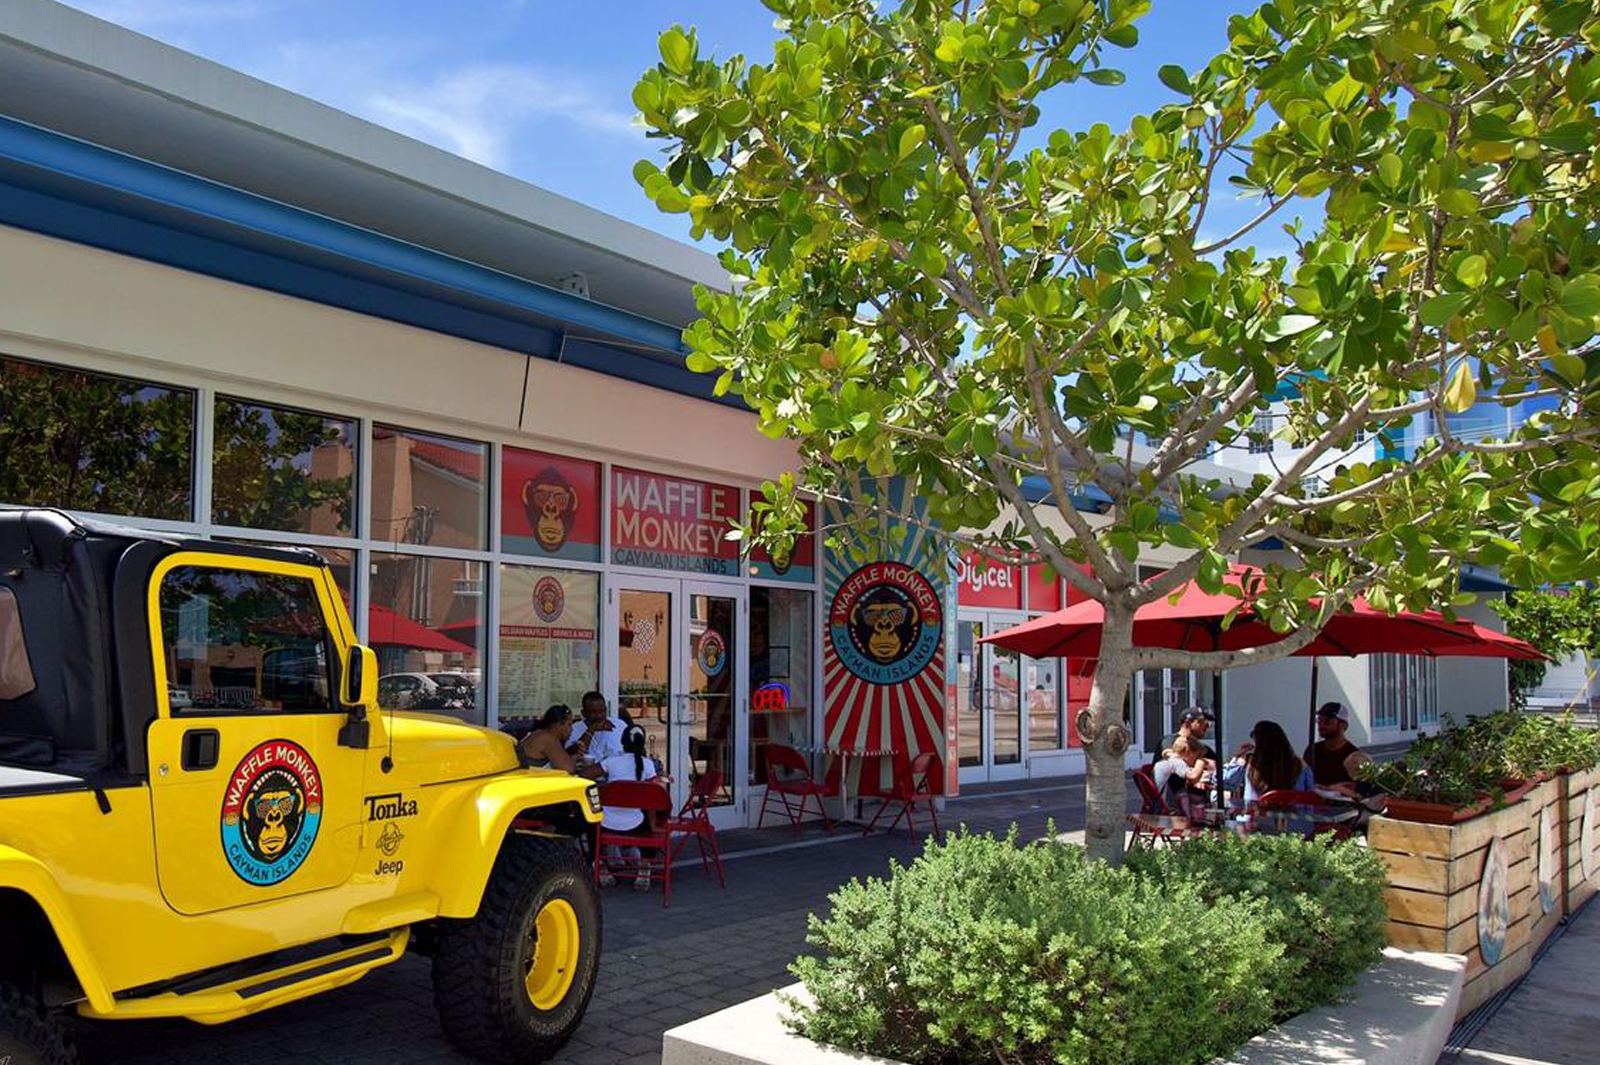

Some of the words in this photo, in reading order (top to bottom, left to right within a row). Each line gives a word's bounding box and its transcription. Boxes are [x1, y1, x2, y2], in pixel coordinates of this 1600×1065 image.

[617, 473, 725, 522] WAFFLE
[617, 508, 724, 554] MONKEY
[615, 548, 672, 569] CAYMAN
[676, 553, 727, 574] ISLANDS
[835, 568, 879, 615] WAFFLE
[883, 567, 936, 613] MONKEY
[837, 635, 880, 679] CAYMAN
[886, 635, 934, 679] ISLANDS
[227, 748, 273, 806] WAFFLE
[276, 746, 318, 798] MONKEY
[364, 793, 418, 821] Tonka
[230, 844, 268, 881] CAYMAN
[272, 834, 312, 878] ISLANDS
[375, 860, 403, 876] Jeep
